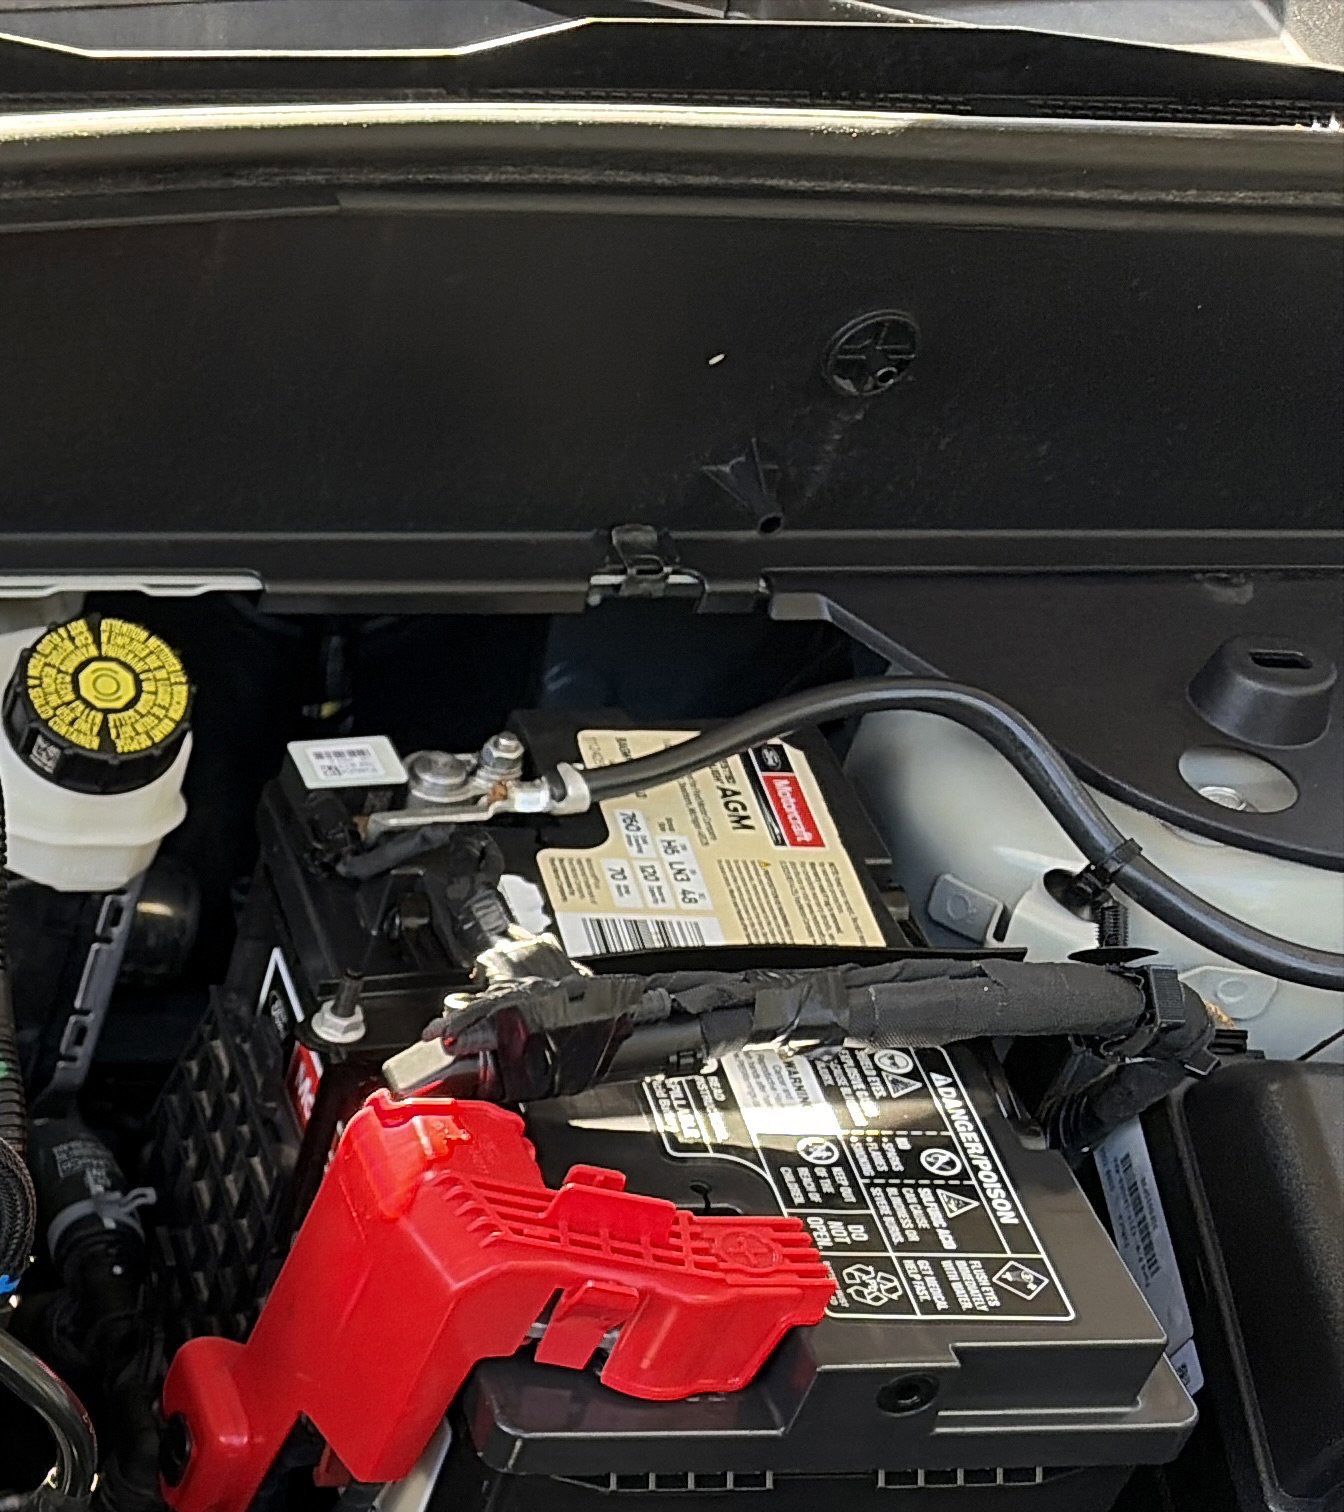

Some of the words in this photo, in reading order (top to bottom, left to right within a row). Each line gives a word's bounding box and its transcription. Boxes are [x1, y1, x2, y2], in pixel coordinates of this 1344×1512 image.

[715, 785, 756, 830] AGM
[770, 779, 815, 842] Motorcraft
[607, 867, 627, 881] 70
[638, 864, 660, 882] 120
[681, 888, 698, 903] 48
[935, 1087, 1019, 1223] DANGER/POISON
[830, 1166, 849, 1185] KEEP
[900, 1187, 918, 1203] CAN
[907, 1204, 931, 1229] CAUSE
[824, 1220, 853, 1244] NOT
[845, 1224, 870, 1241] DO
[901, 1259, 922, 1279] HELP
[915, 1259, 934, 1275] GET
[939, 1259, 959, 1280] WITH
[921, 1275, 949, 1311] MEDICAL
[953, 1259, 989, 1311] IMMEDIATELY
[967, 1260, 990, 1285] FLUSH
[980, 1287, 1000, 1306] EYES
